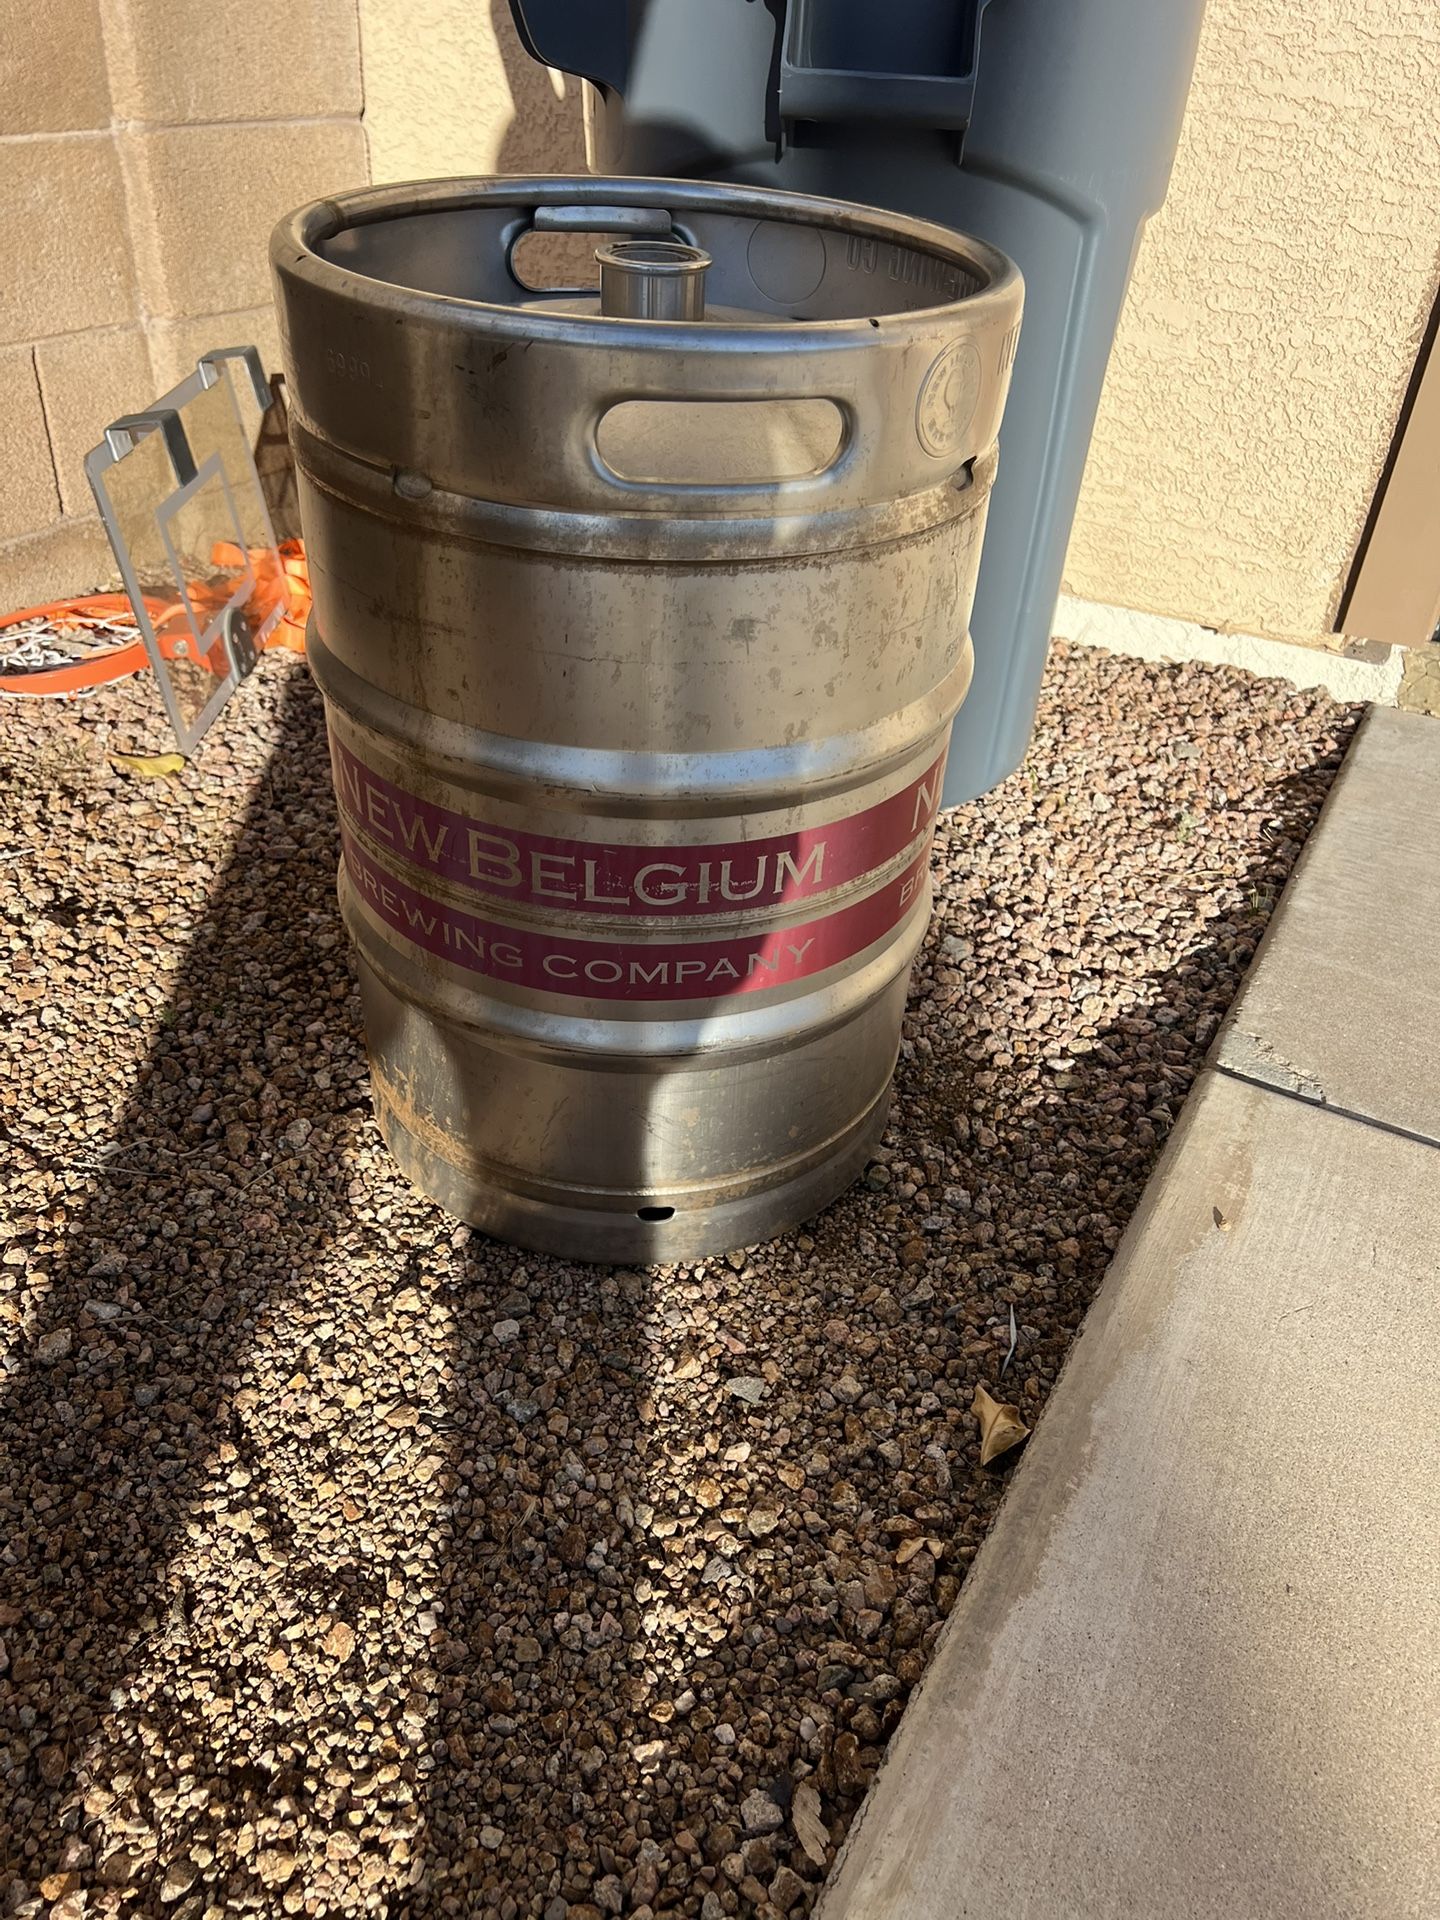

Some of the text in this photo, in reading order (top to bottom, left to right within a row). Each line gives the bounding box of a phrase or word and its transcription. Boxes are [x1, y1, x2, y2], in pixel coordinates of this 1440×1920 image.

[335, 745, 828, 907] NEW BELGIUM
[349, 850, 815, 985] BREWING COMPANY
